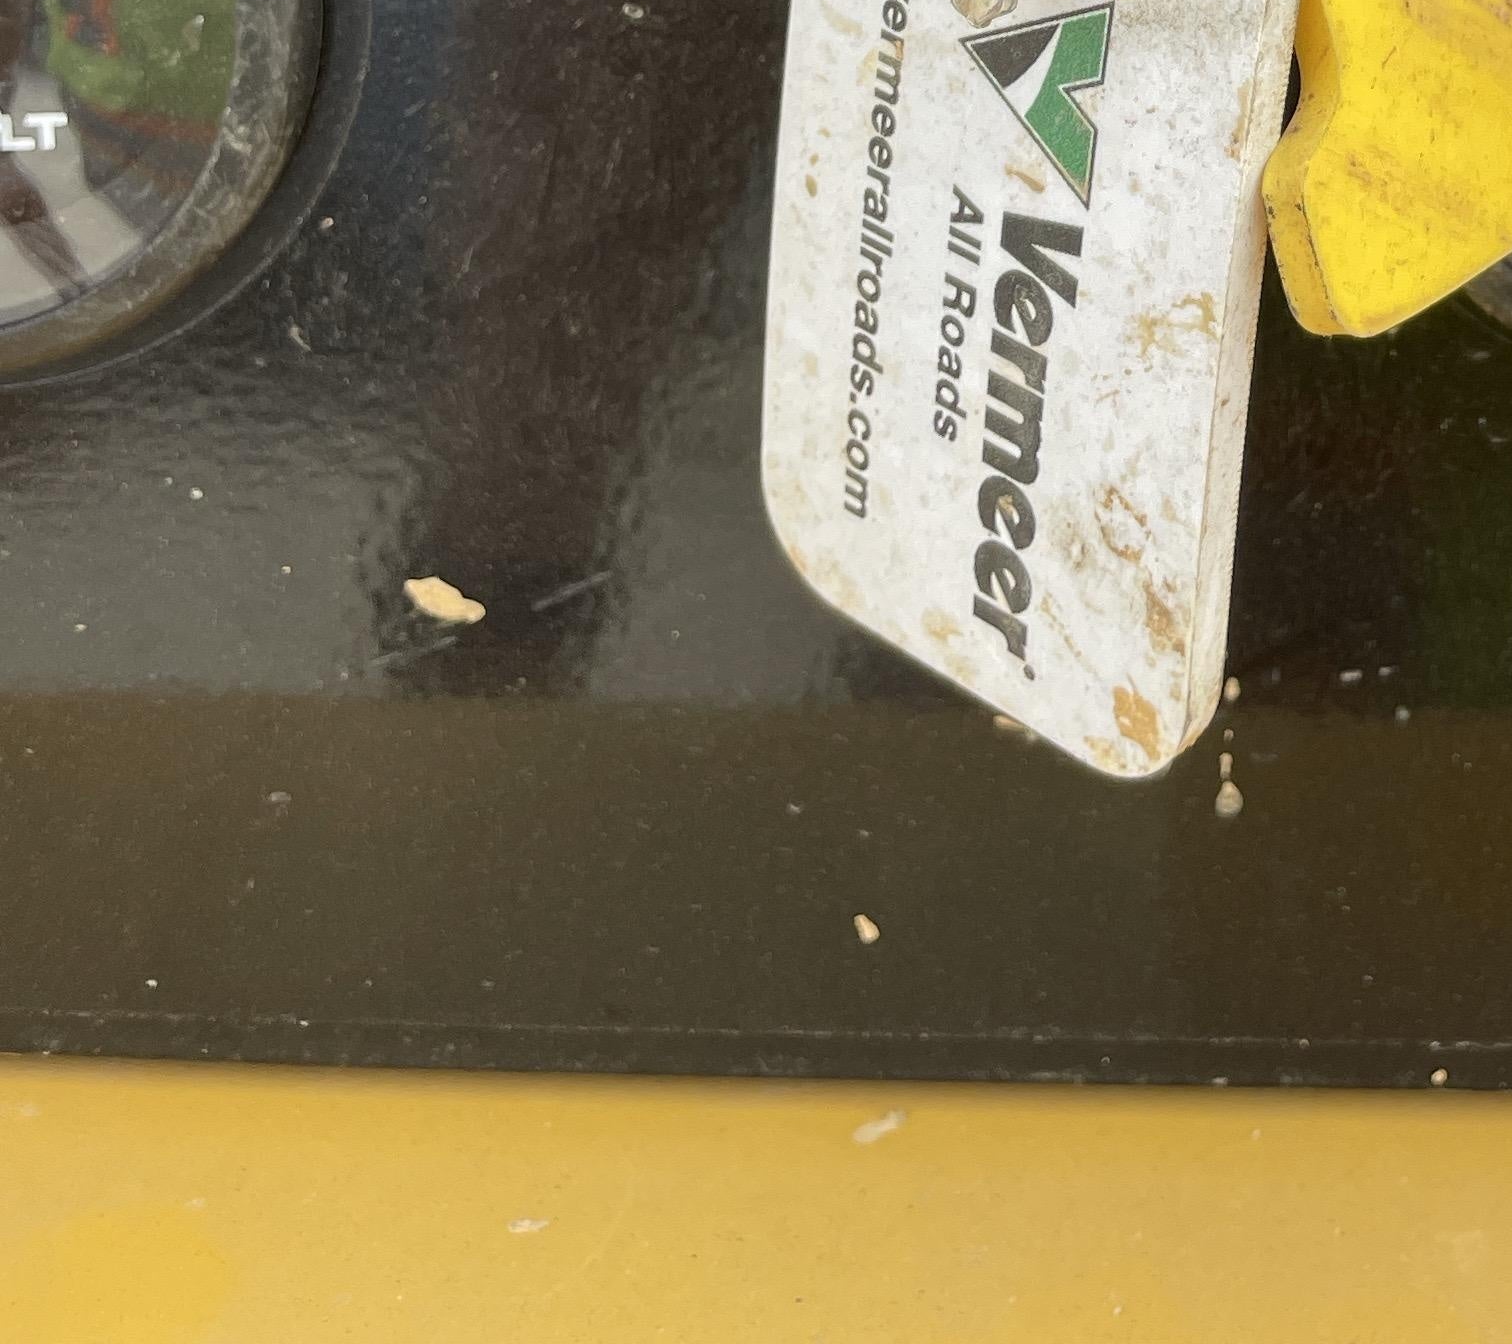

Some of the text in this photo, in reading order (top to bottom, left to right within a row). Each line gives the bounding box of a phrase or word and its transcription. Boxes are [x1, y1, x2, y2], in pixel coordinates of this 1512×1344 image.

[0, 112, 68, 151] LT
[933, 183, 984, 443] All Roads
[973, 211, 1084, 662] Vermeer
